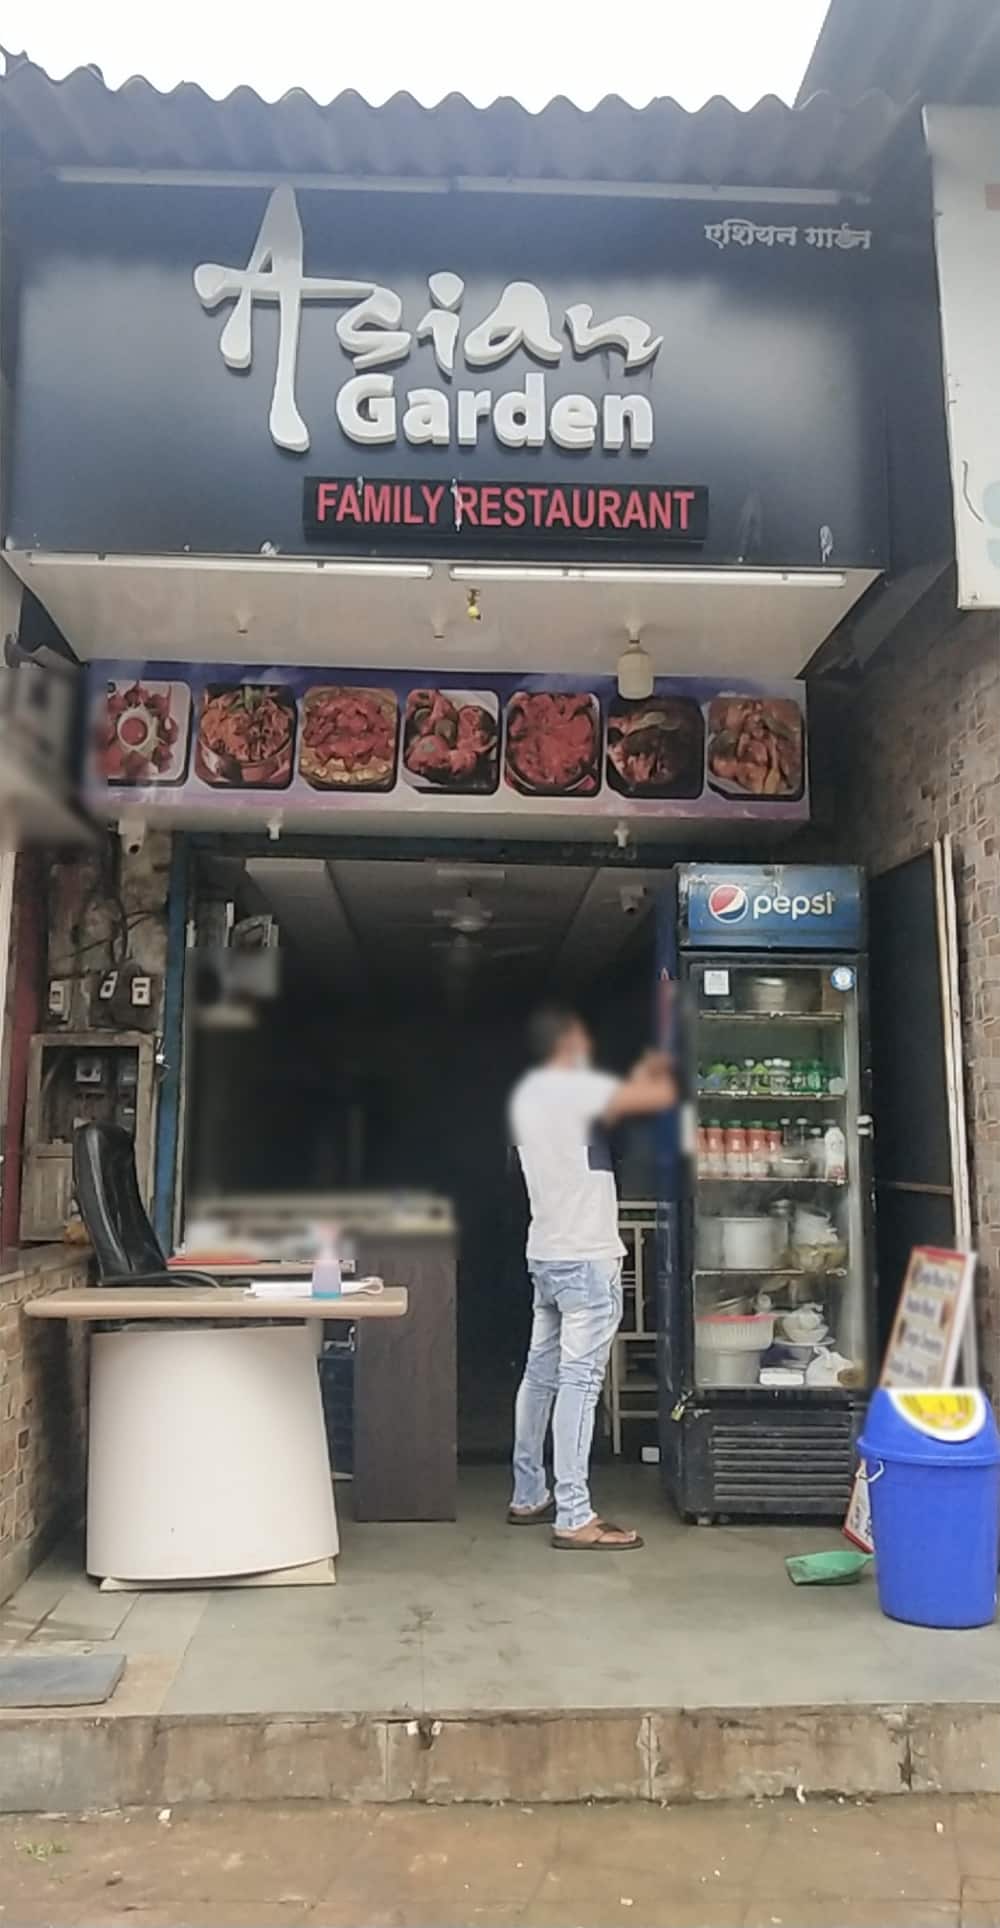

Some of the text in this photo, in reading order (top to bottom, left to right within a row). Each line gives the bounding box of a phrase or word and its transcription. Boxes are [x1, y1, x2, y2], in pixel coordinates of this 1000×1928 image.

[704, 218, 798, 249] एशियन
[193, 183, 664, 452] Asian
[336, 372, 654, 450] Garden
[316, 482, 695, 531] FAMILY RESTAURANT
[753, 891, 834, 920] pepsi
